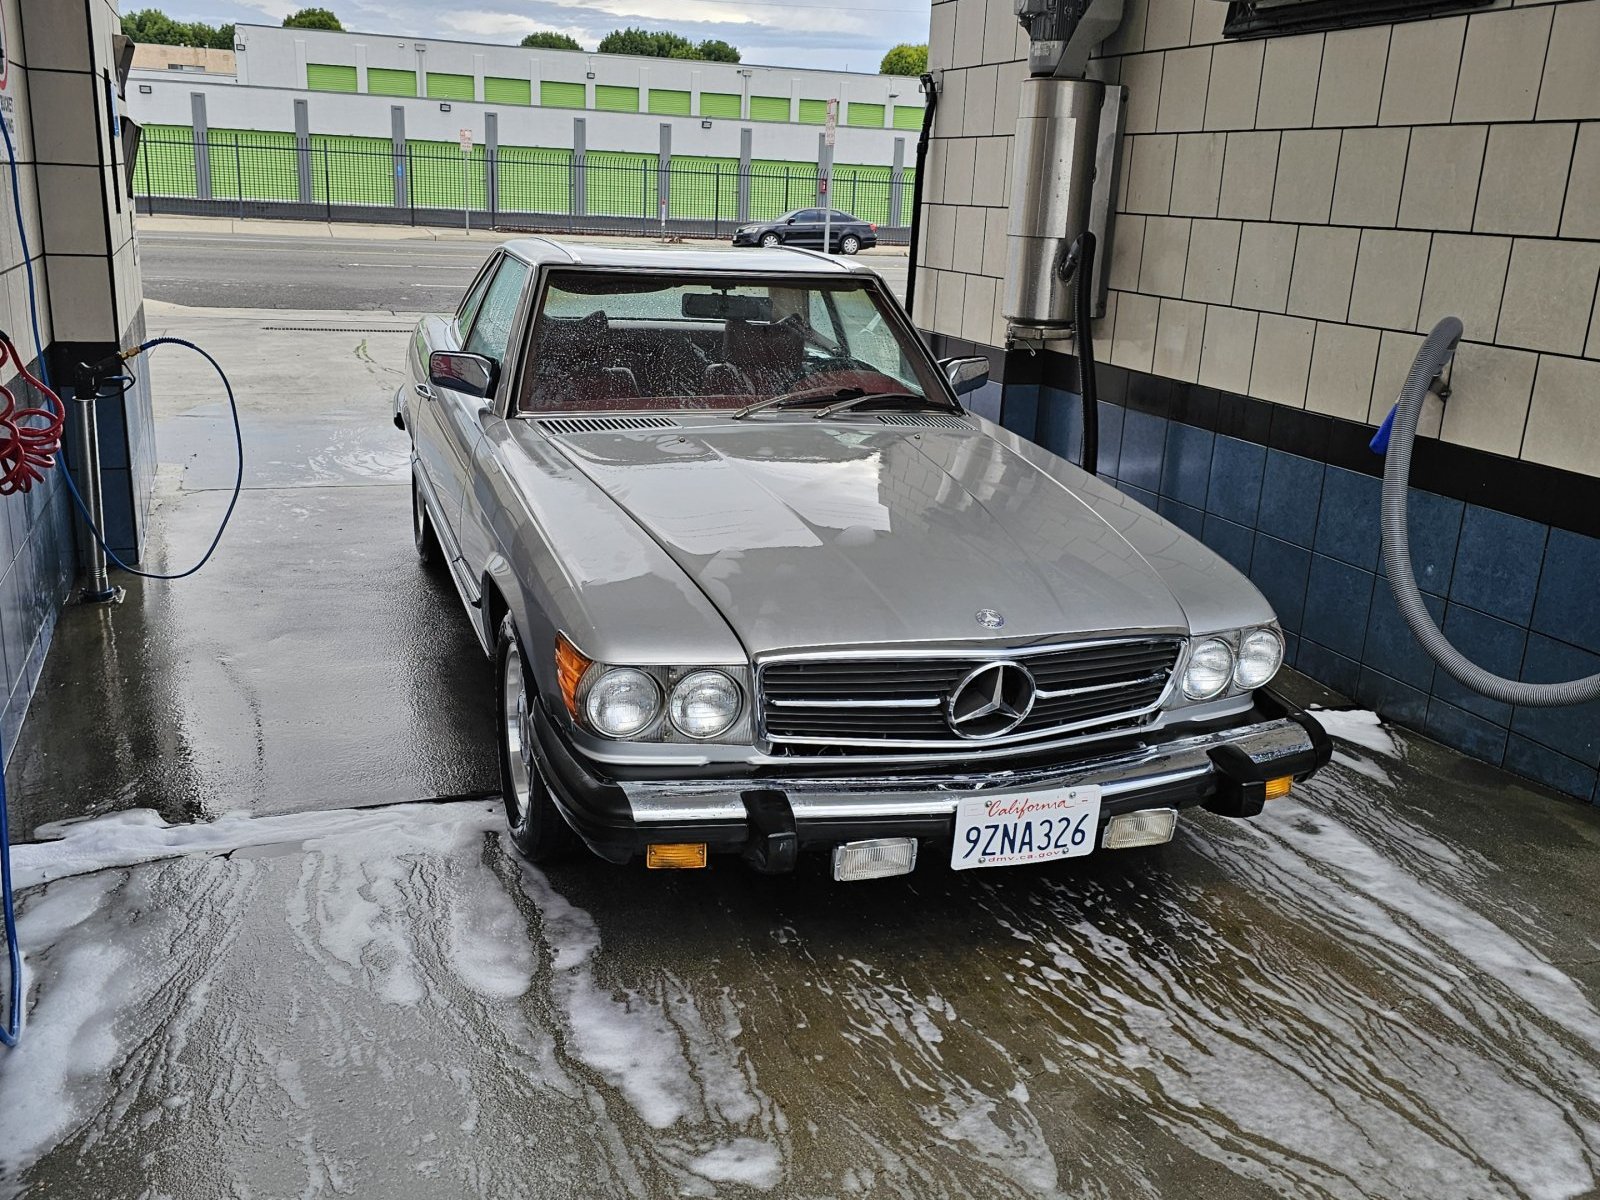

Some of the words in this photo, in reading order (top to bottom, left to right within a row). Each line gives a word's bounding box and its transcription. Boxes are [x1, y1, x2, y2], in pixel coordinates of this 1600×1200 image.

[988, 798, 1075, 819] California
[962, 813, 1089, 859] 9ZNA326
[987, 849, 1061, 863] dmv.ca.gov
